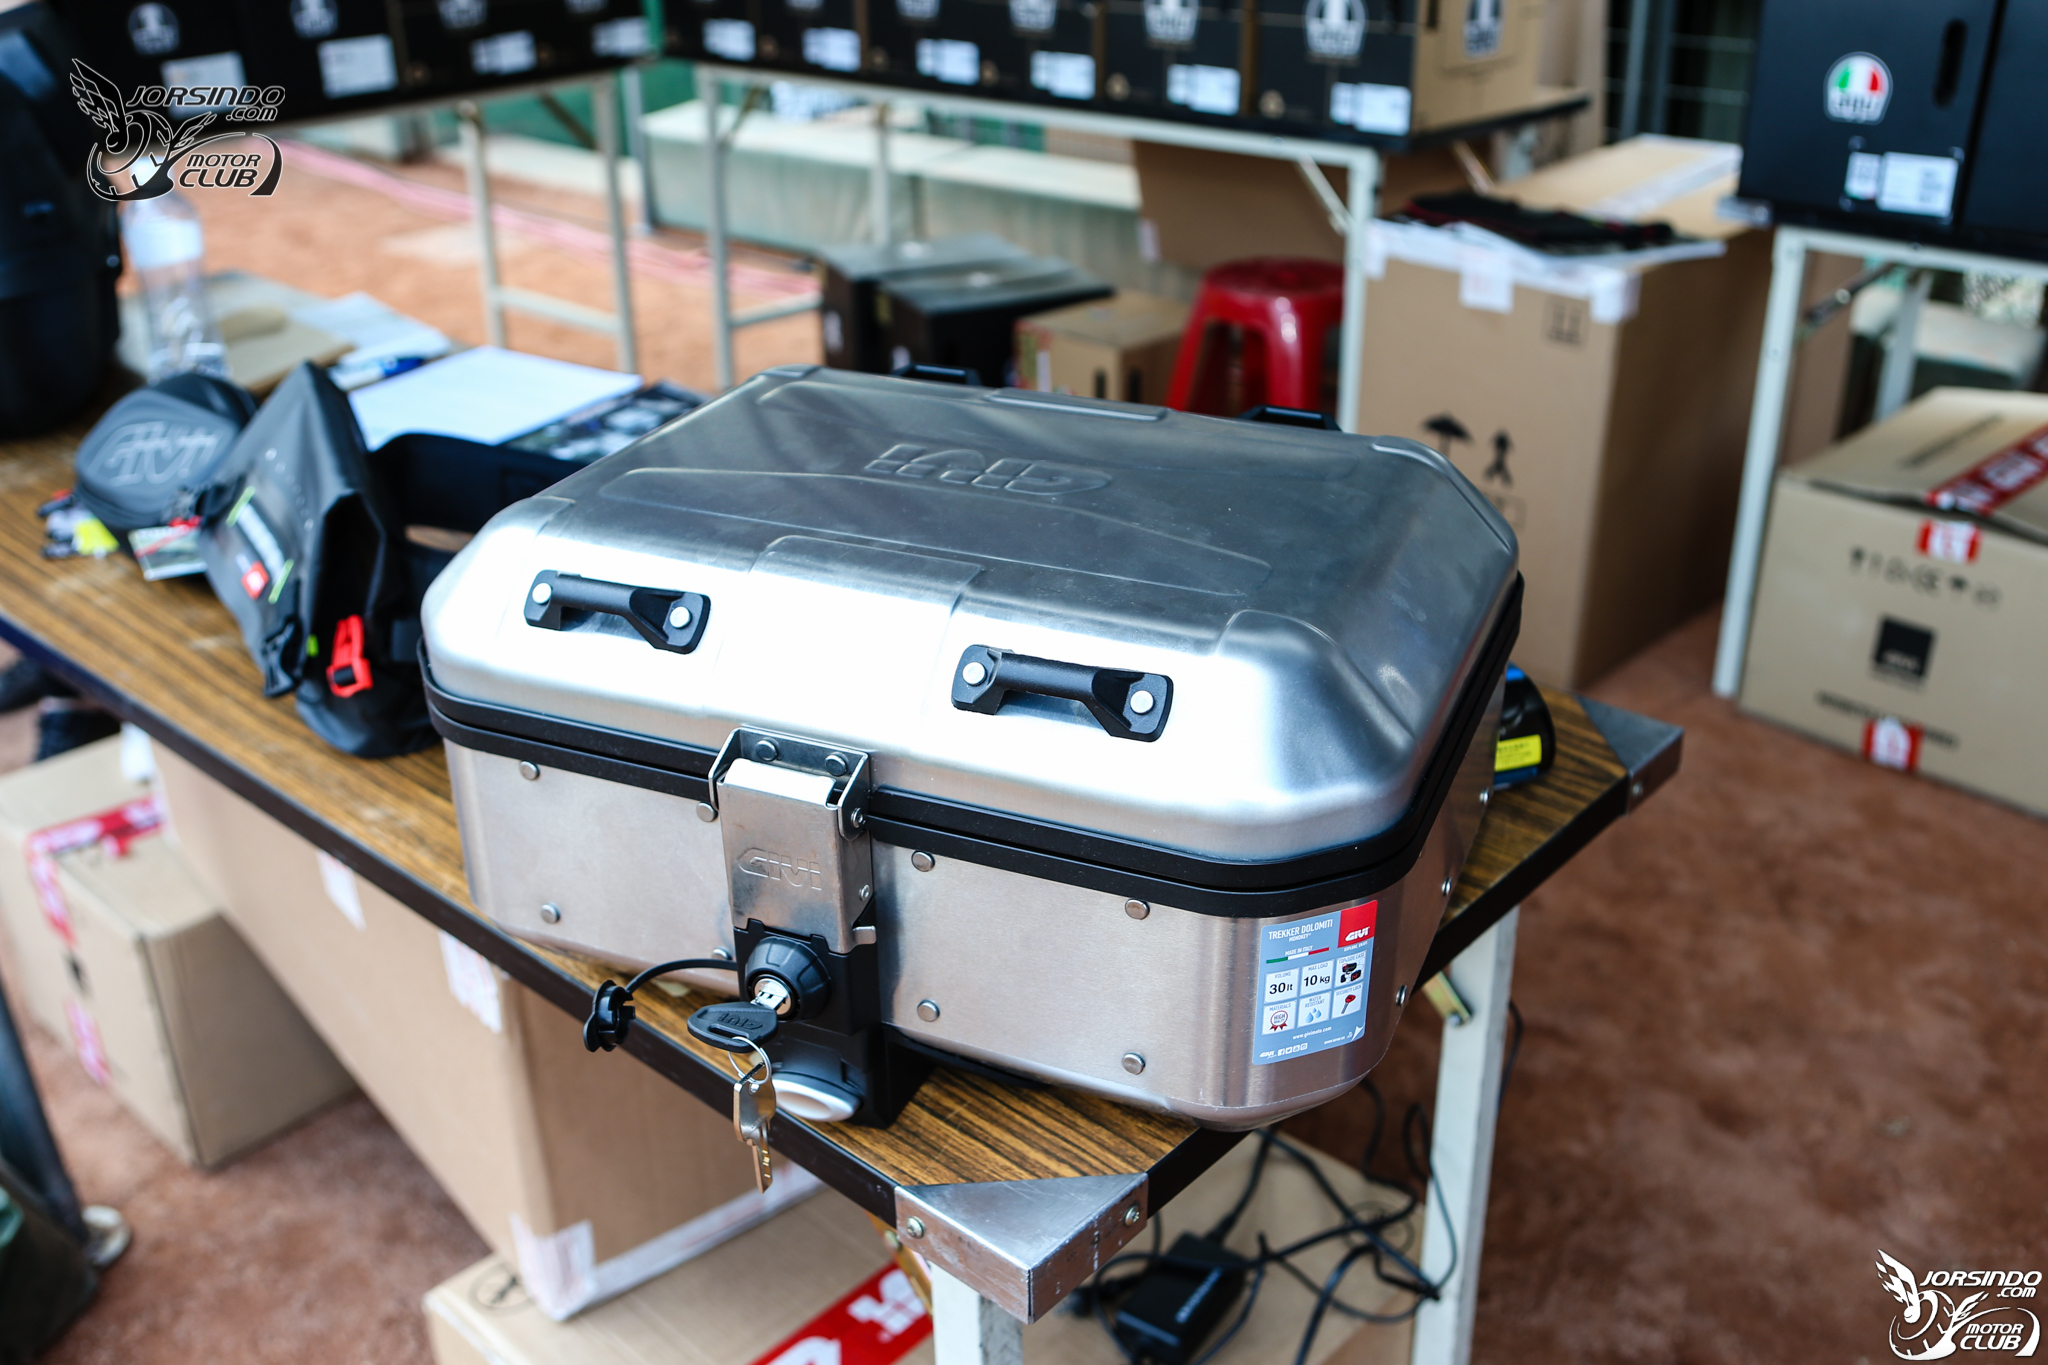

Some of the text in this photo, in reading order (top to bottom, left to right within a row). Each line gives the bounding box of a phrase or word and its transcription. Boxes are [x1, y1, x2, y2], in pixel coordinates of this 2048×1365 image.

[736, 847, 823, 891] GIVI
[1268, 919, 1334, 940] TREKKER DOLOMITI
[1344, 926, 1371, 942] GIVI
[1303, 975, 1331, 987] 10 kg
